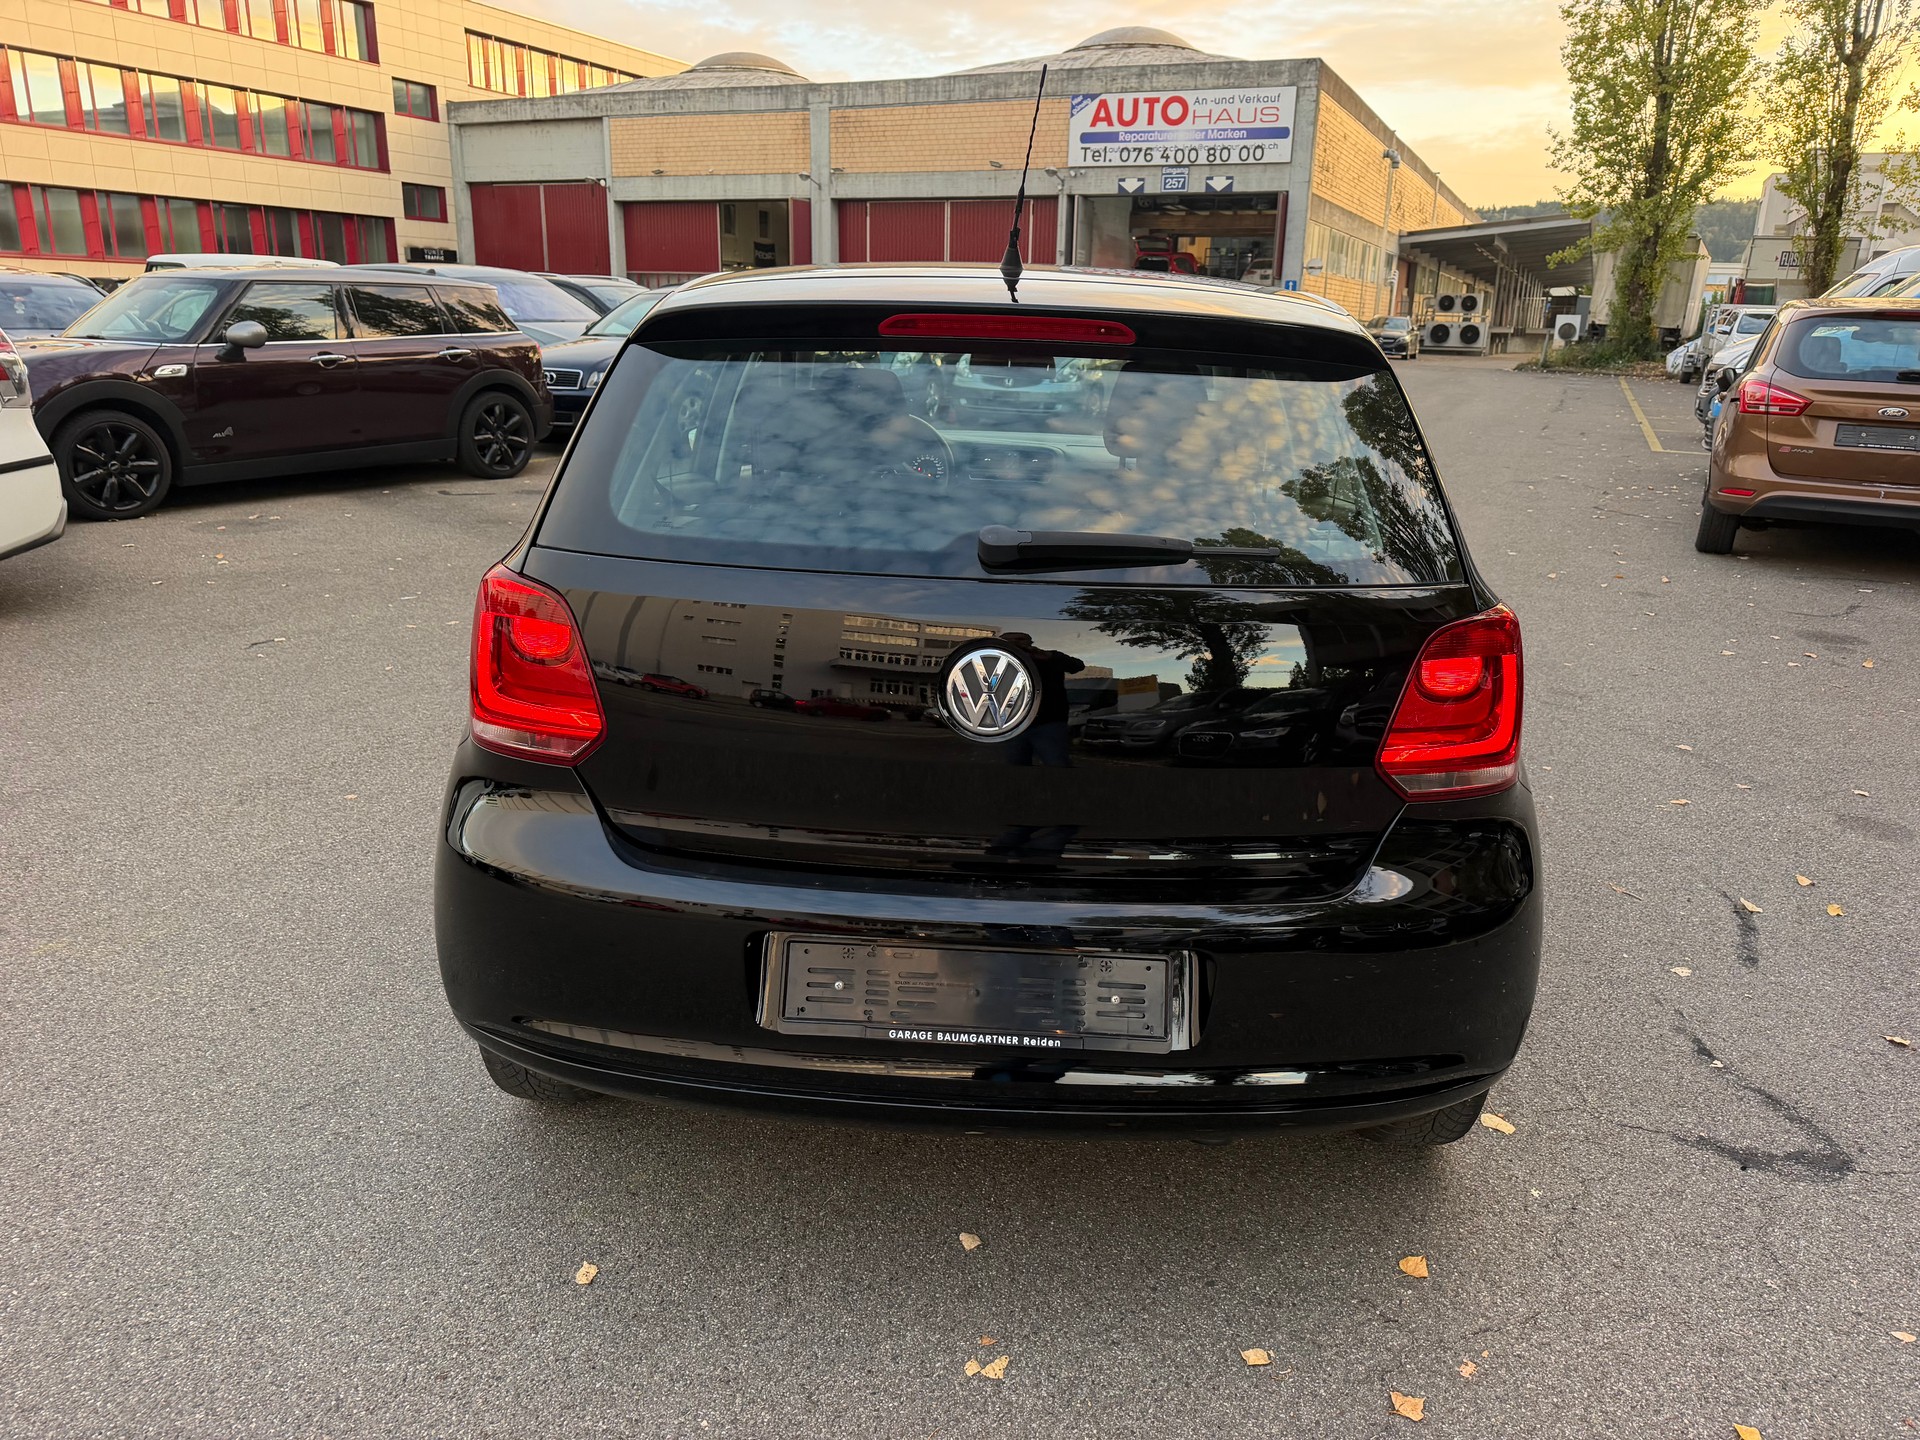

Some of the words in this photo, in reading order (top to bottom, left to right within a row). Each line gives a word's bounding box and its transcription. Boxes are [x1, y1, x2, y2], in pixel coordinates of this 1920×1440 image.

[1193, 96, 1208, 105] An
[1238, 93, 1281, 104] Verkauf
[1089, 95, 1189, 127] AUTO
[1192, 106, 1280, 125] HAUS
[1207, 129, 1247, 139] Marken
[1080, 146, 1112, 163] Tel.
[1119, 146, 1154, 163] 076
[1160, 147, 1199, 164] 400
[1206, 147, 1231, 163] 80
[1238, 145, 1265, 162] 00
[1162, 166, 1189, 175] Eingang
[1165, 178, 1185, 189] 257
[888, 1029, 933, 1040] GARAGE
[937, 1032, 1019, 1045] BAUMGARTNER
[1023, 1036, 1061, 1047] Reiden
